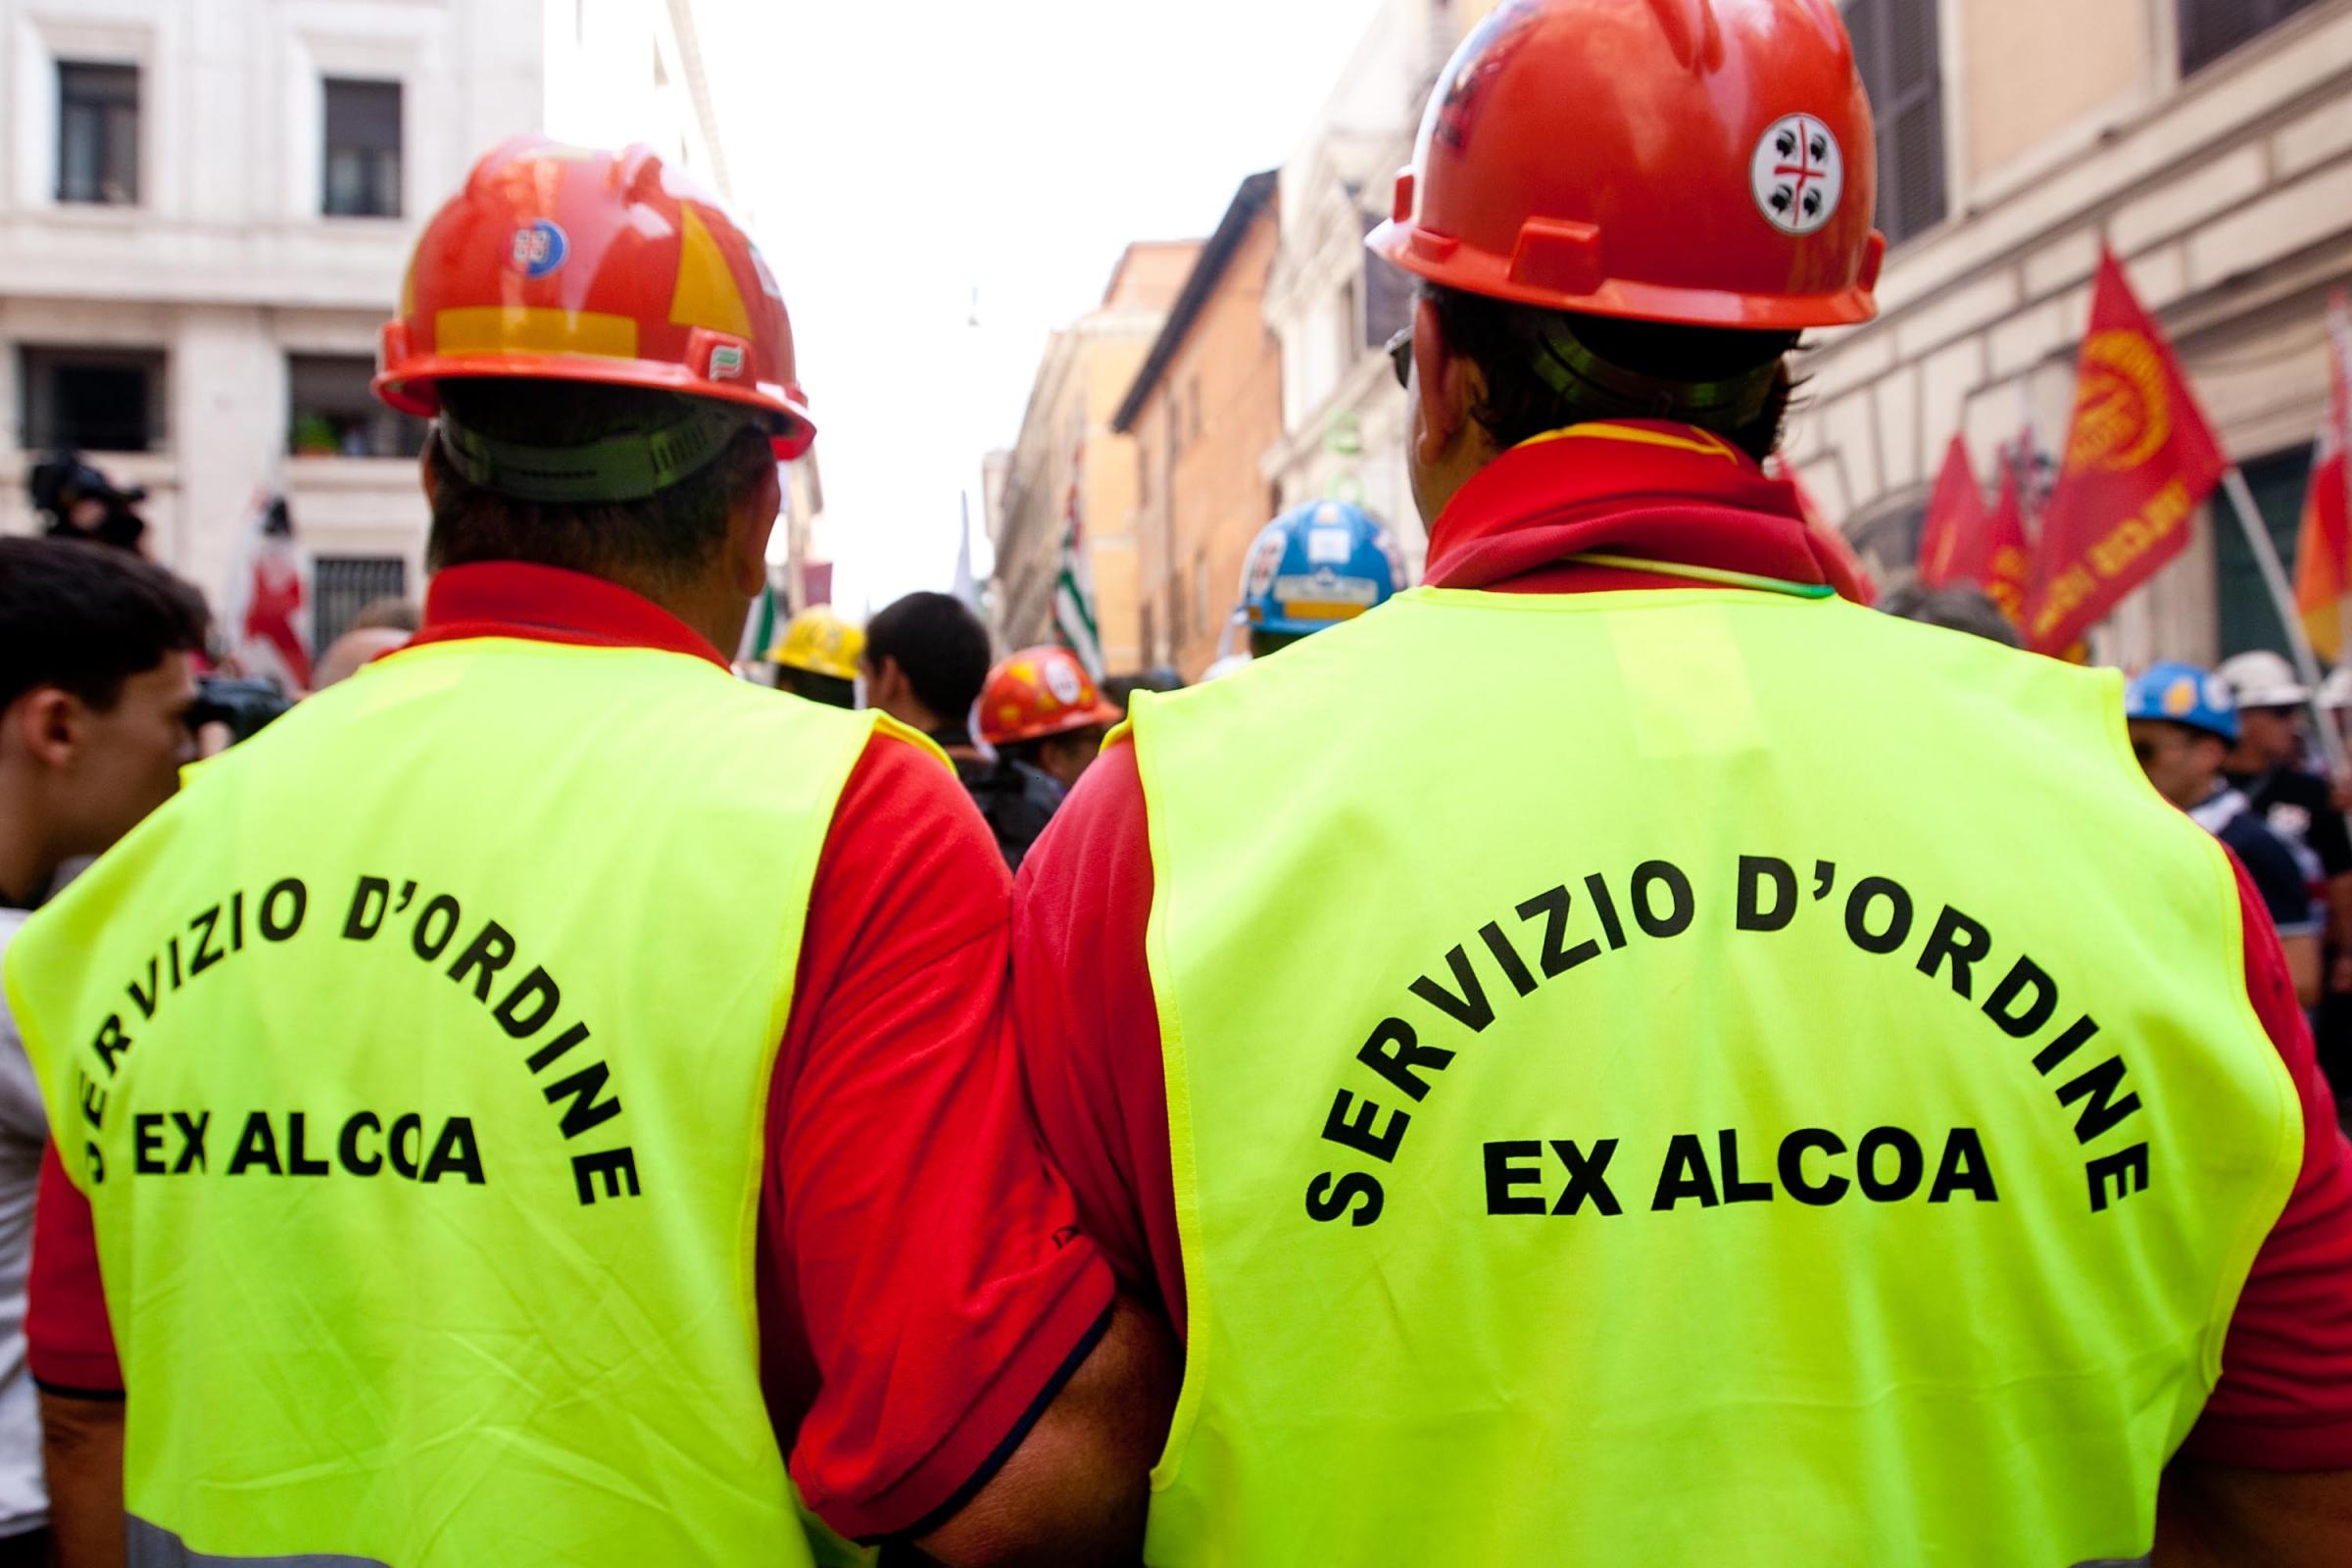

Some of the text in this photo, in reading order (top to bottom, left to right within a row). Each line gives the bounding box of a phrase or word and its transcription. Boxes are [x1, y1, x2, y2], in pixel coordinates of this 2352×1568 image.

[342, 875, 642, 1206] D'ORDINE
[1305, 854, 2150, 1228] SERVIZIO D'ORDINE
[134, 1109, 487, 1186] EX ALCOA
[1483, 1125, 2000, 1217] EX ALCOA
